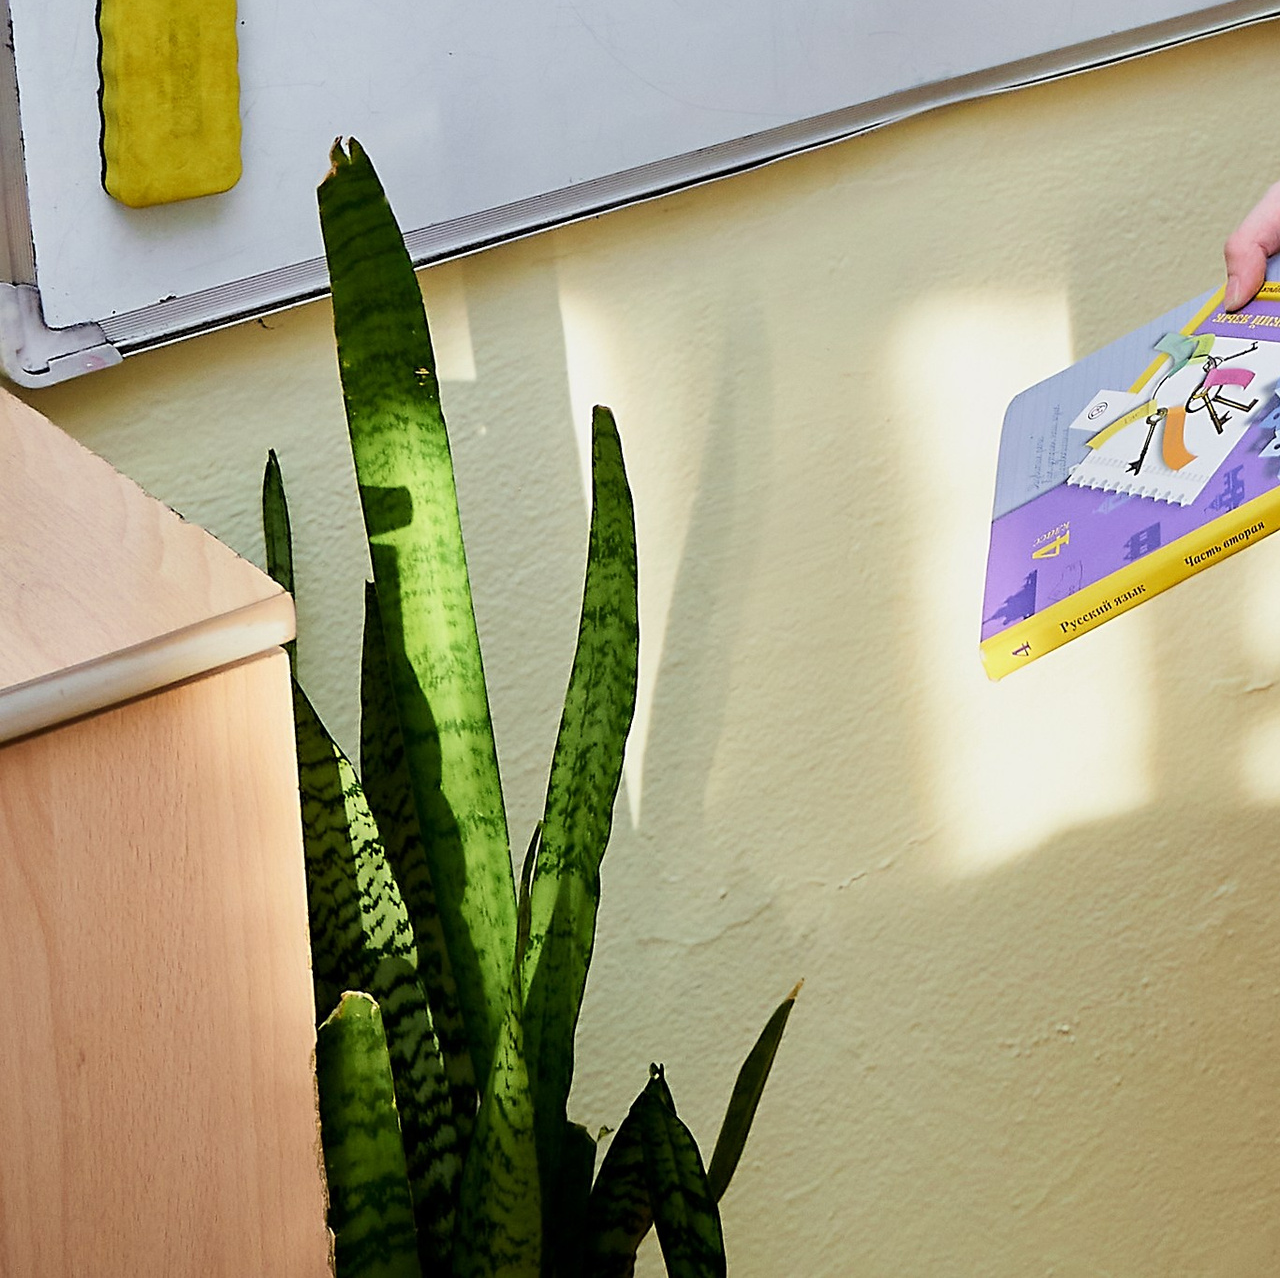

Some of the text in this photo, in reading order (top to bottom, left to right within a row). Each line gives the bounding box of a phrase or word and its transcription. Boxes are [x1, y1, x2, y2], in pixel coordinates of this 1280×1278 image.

[1212, 312, 1253, 325] язык
[1031, 529, 1071, 560] 4
[1183, 519, 1266, 568] Часть вторая
[1059, 583, 1147, 634] Русский язык
[1011, 640, 1032, 657] 4
